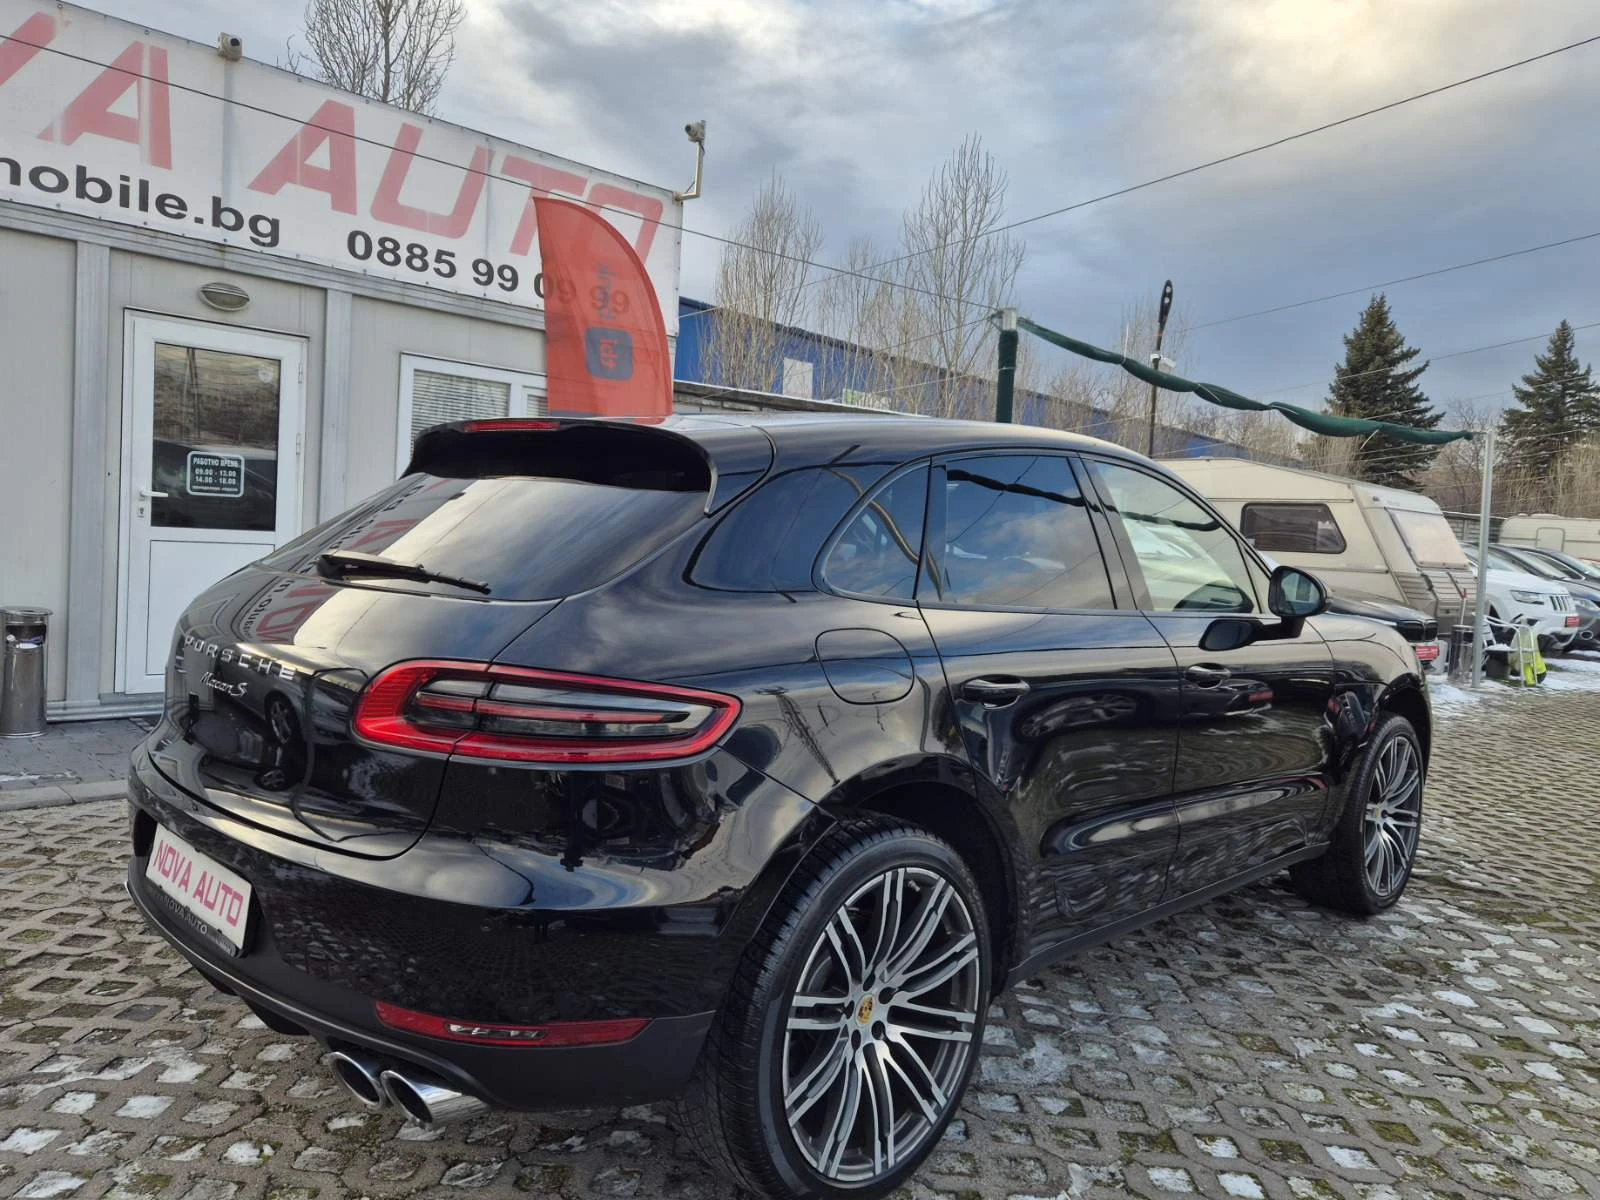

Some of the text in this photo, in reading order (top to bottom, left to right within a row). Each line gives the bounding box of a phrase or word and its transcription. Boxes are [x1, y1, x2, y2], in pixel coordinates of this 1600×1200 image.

[247, 99, 663, 266] AUTO
[347, 230, 457, 278] 0885
[472, 258, 519, 292] 99
[184, 634, 297, 680] PORSCHE
[201, 671, 249, 697] Macan S
[153, 839, 244, 928] NOVA AUTO
